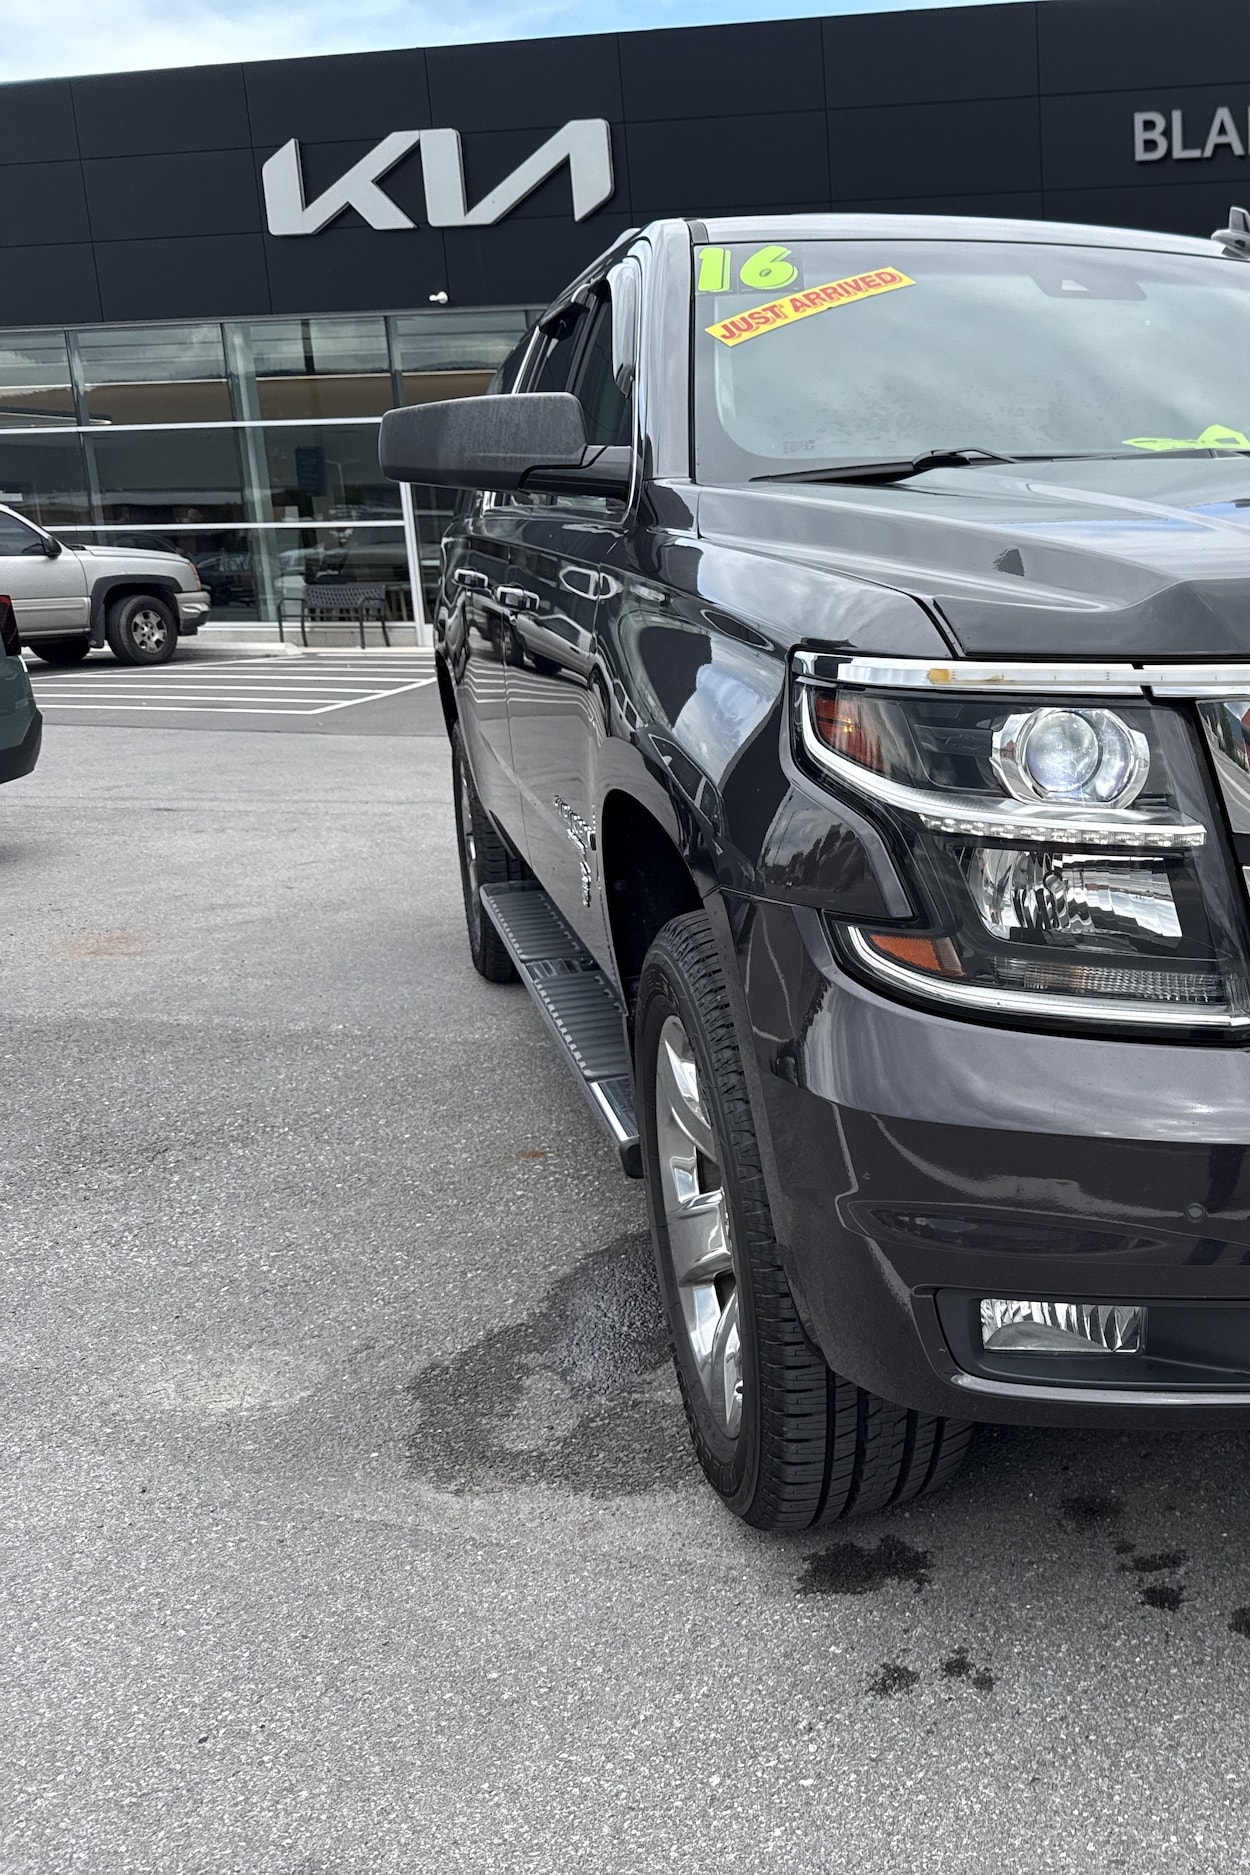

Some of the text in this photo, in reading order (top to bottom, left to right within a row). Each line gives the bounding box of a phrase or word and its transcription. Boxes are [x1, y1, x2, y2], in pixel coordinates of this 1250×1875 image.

[262, 117, 614, 237] KIA
[698, 245, 798, 292] 16
[720, 271, 903, 340] JUST ARRIVED
